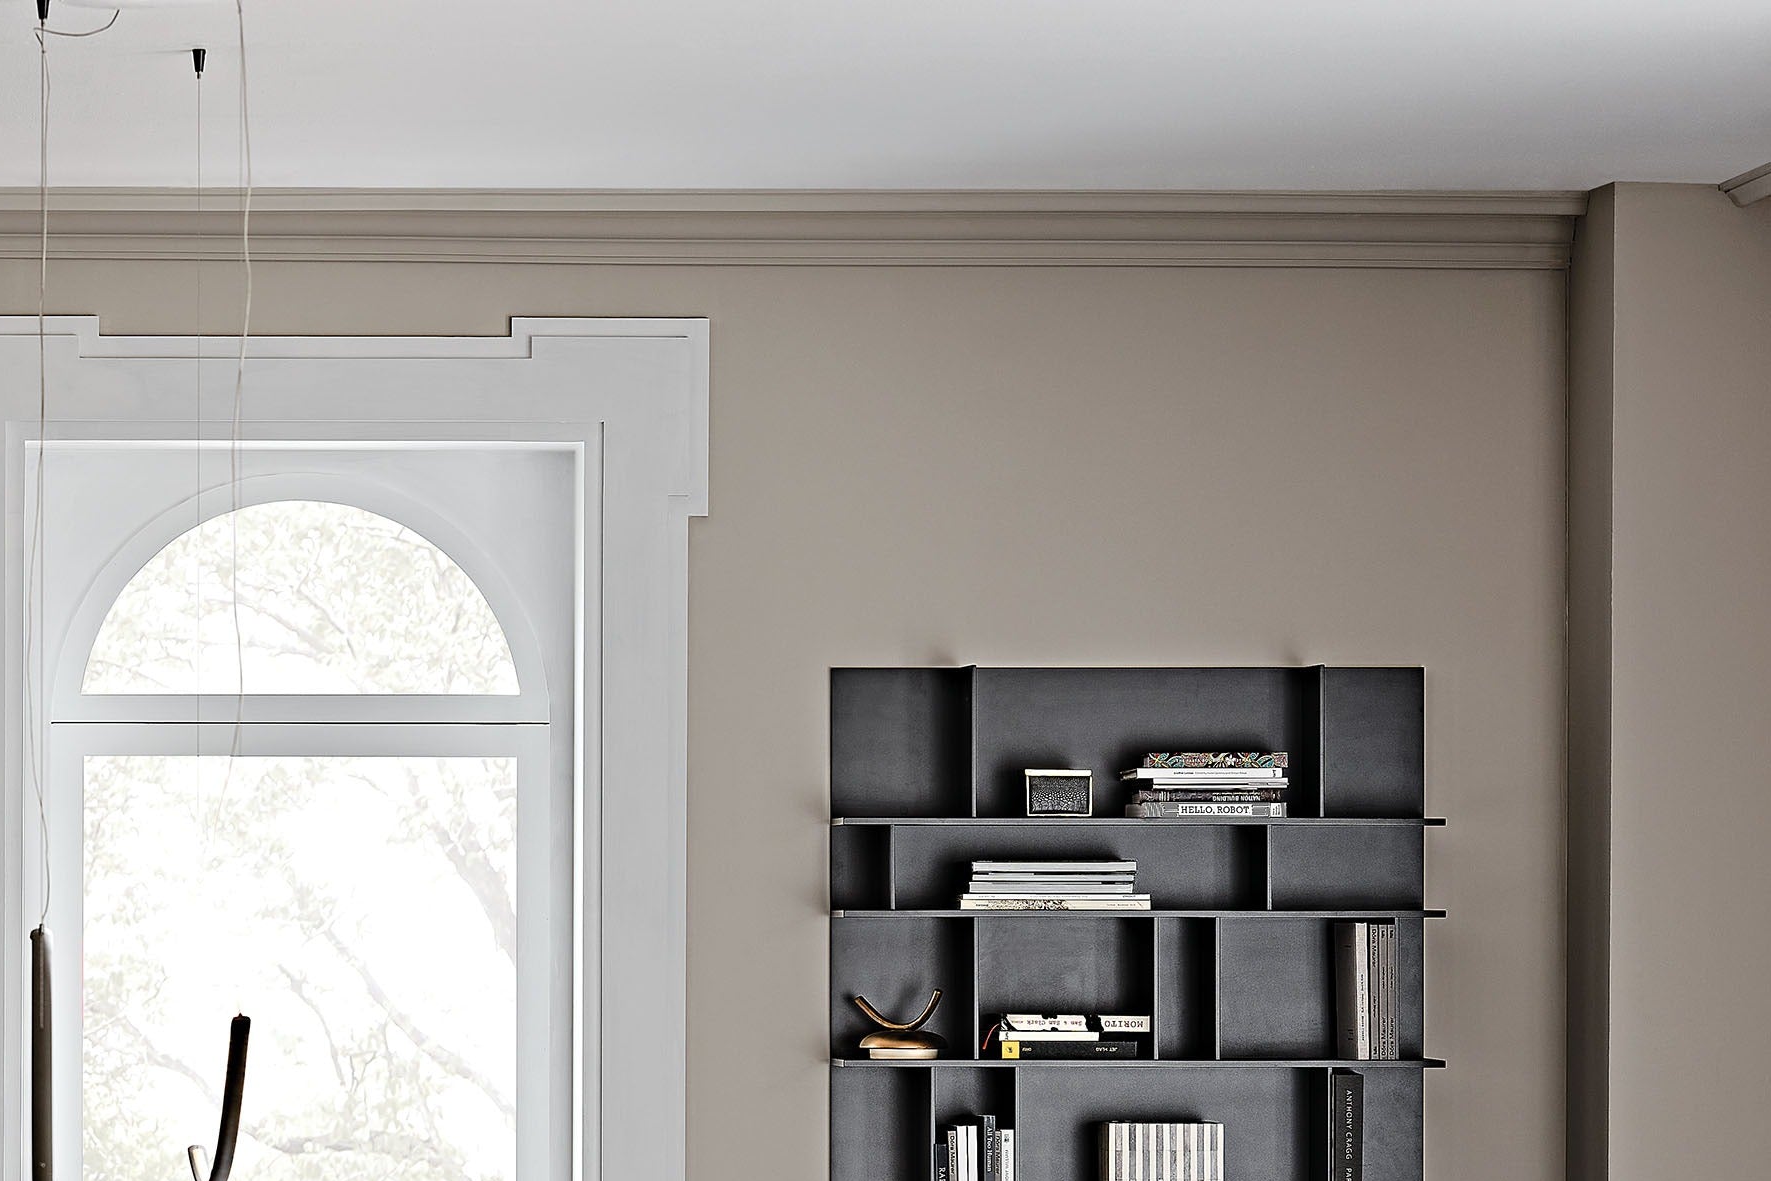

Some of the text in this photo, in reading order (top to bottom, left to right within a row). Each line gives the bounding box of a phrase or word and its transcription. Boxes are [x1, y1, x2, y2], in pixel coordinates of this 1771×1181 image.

[1104, 1020, 1144, 1028] MORITO
[1345, 1089, 1353, 1130] ANTHONY
[1345, 1132, 1353, 1160] CRAGG
